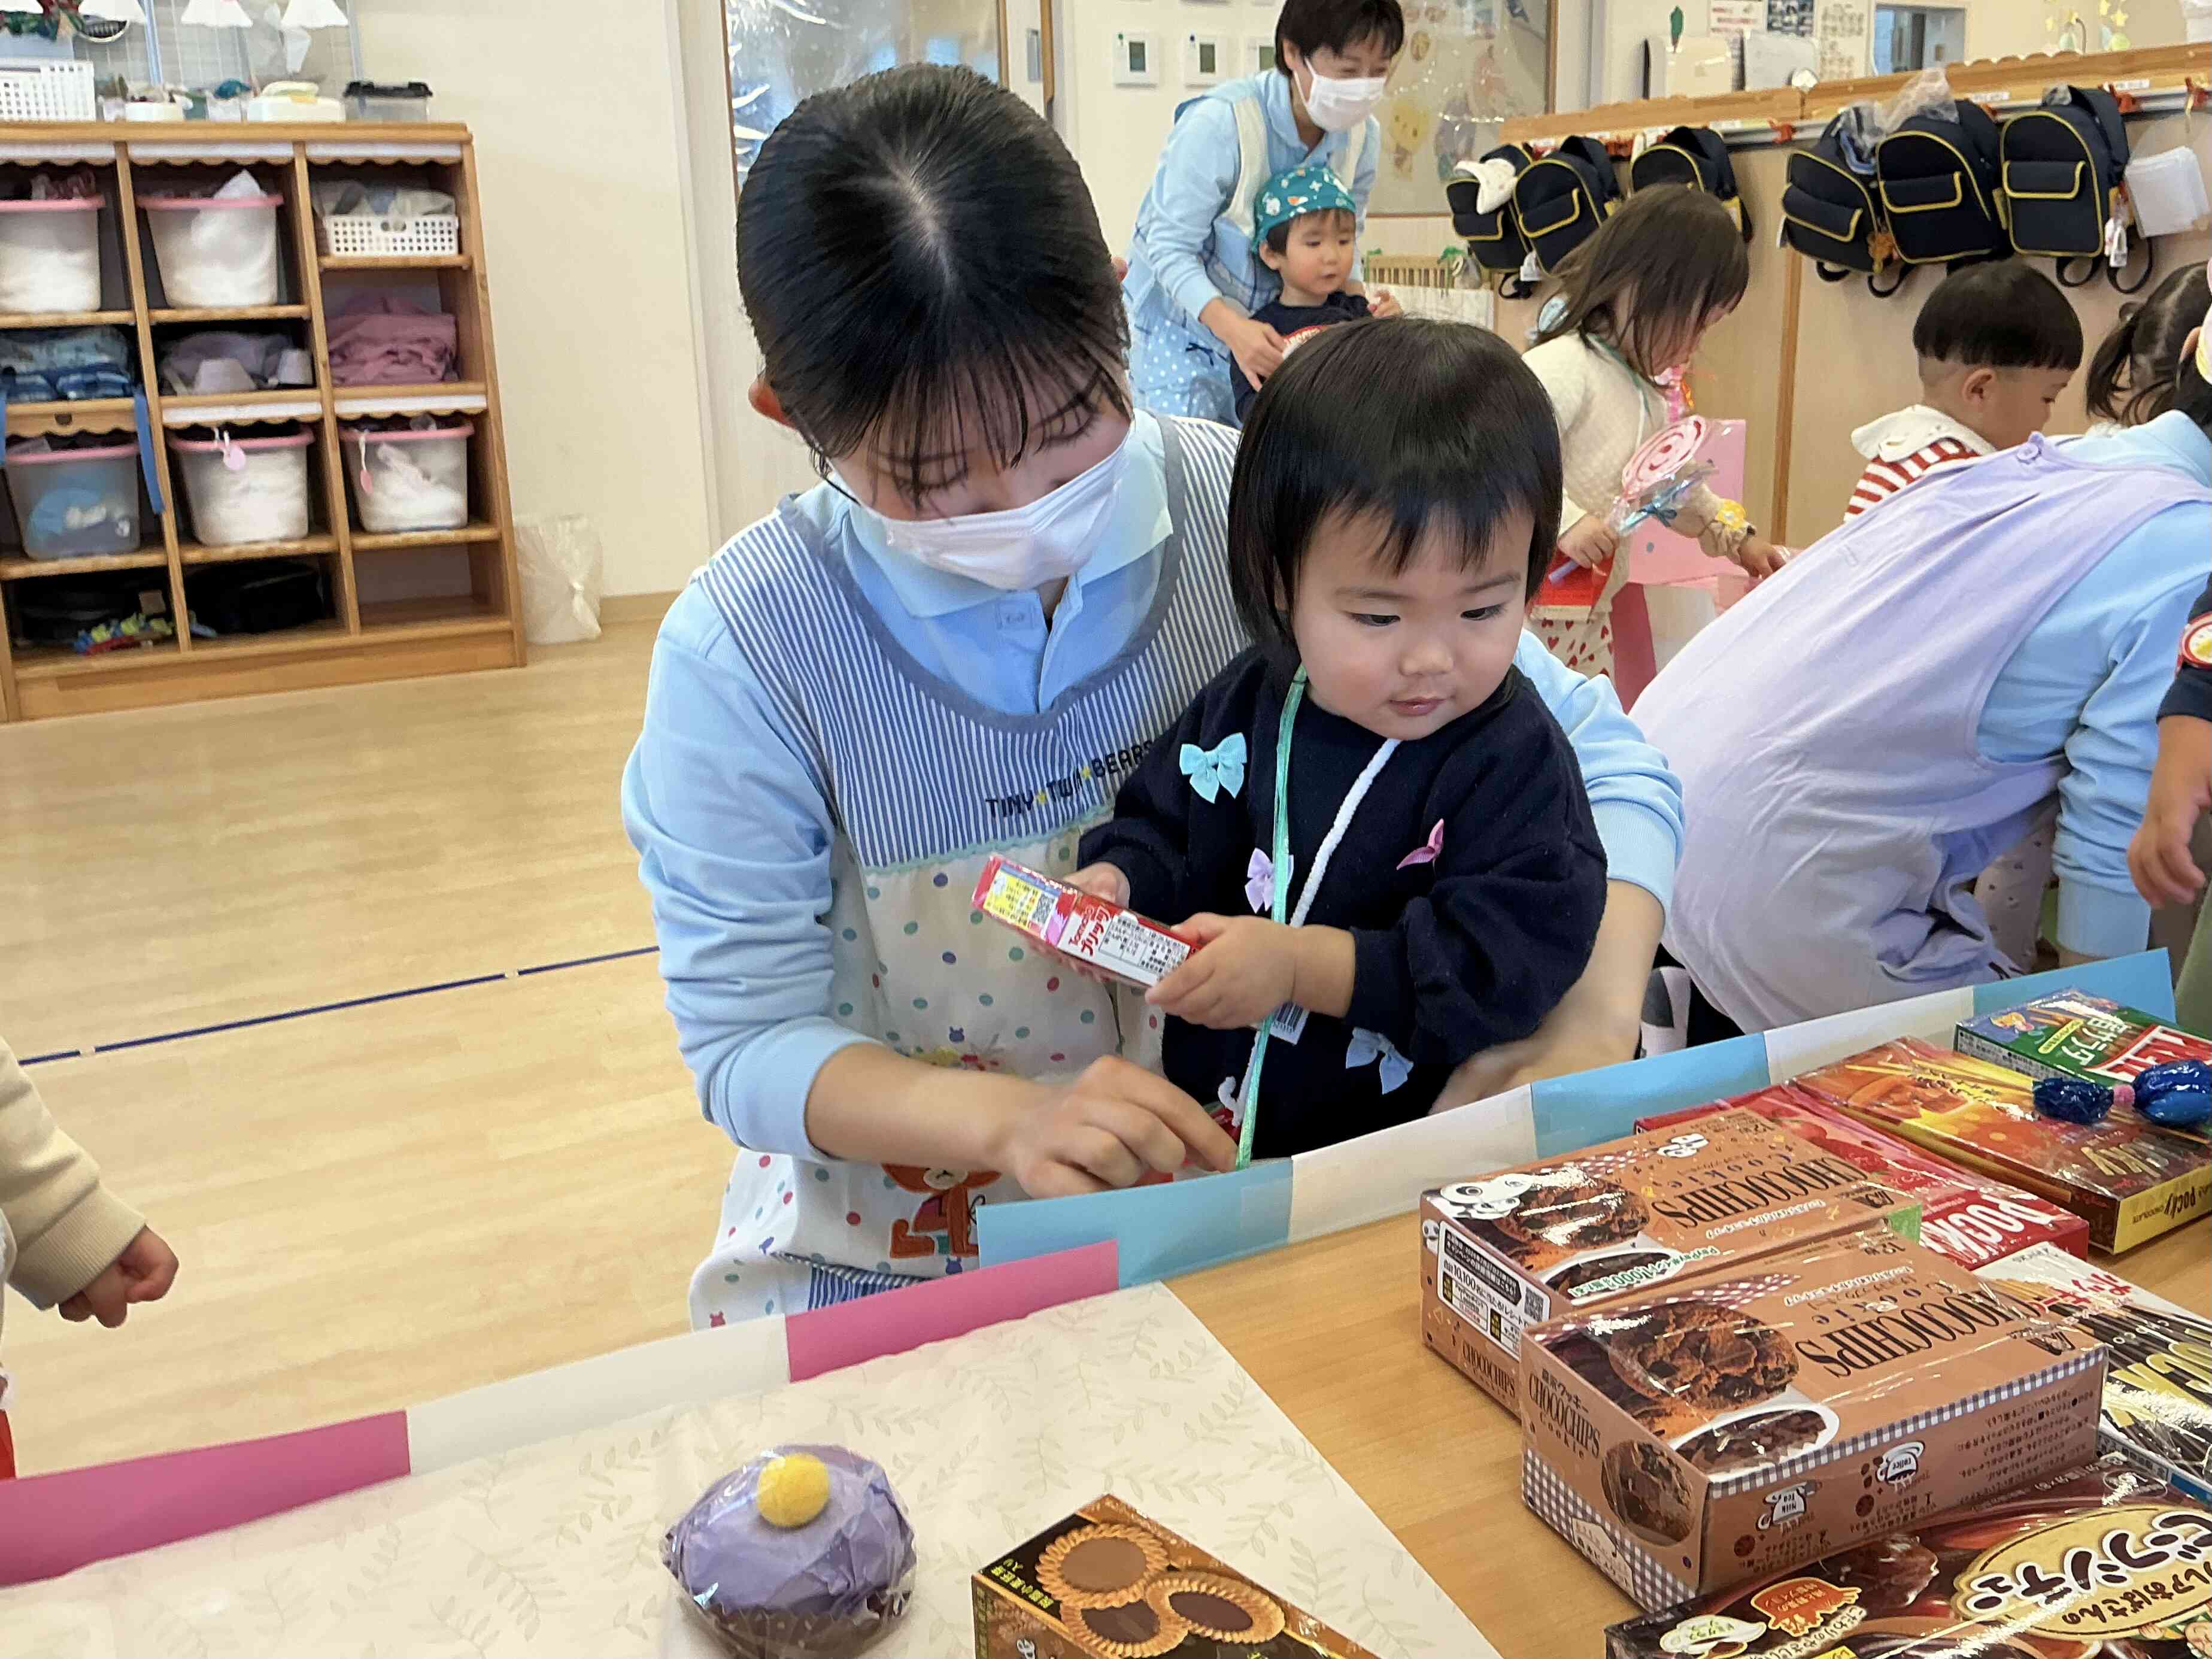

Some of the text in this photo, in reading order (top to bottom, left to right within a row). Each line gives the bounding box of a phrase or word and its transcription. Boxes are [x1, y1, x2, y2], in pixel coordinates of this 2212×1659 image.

[985, 790, 1034, 818] TINY
[1651, 1157, 1868, 1230] CHOCOCHIPS
[2164, 1186, 2196, 1219] POCKY
[1528, 1373, 1601, 1459] CHOCOCHIPS
